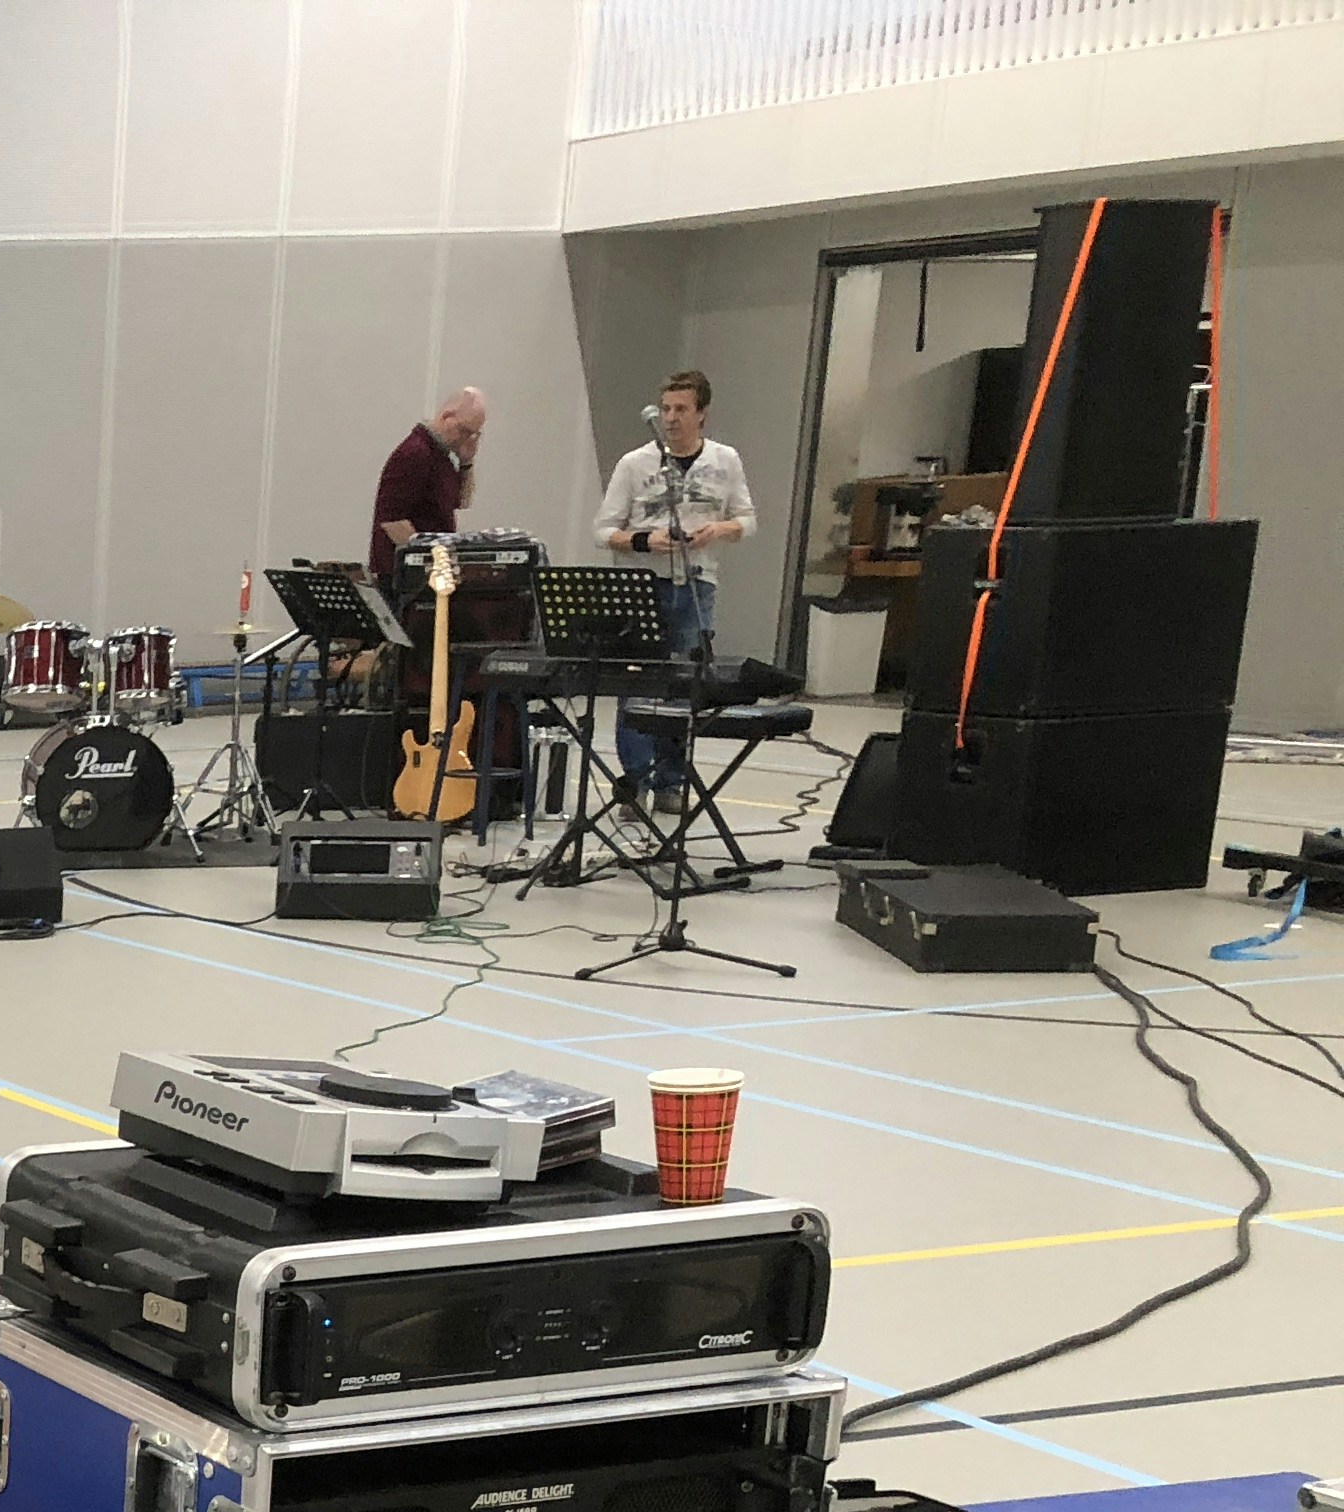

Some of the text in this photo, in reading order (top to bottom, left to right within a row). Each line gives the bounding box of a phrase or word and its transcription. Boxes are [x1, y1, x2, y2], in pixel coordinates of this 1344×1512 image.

[64, 746, 136, 779] Pearl
[154, 1081, 249, 1132] Pioneer
[471, 1489, 527, 1510] AUDIENCE
